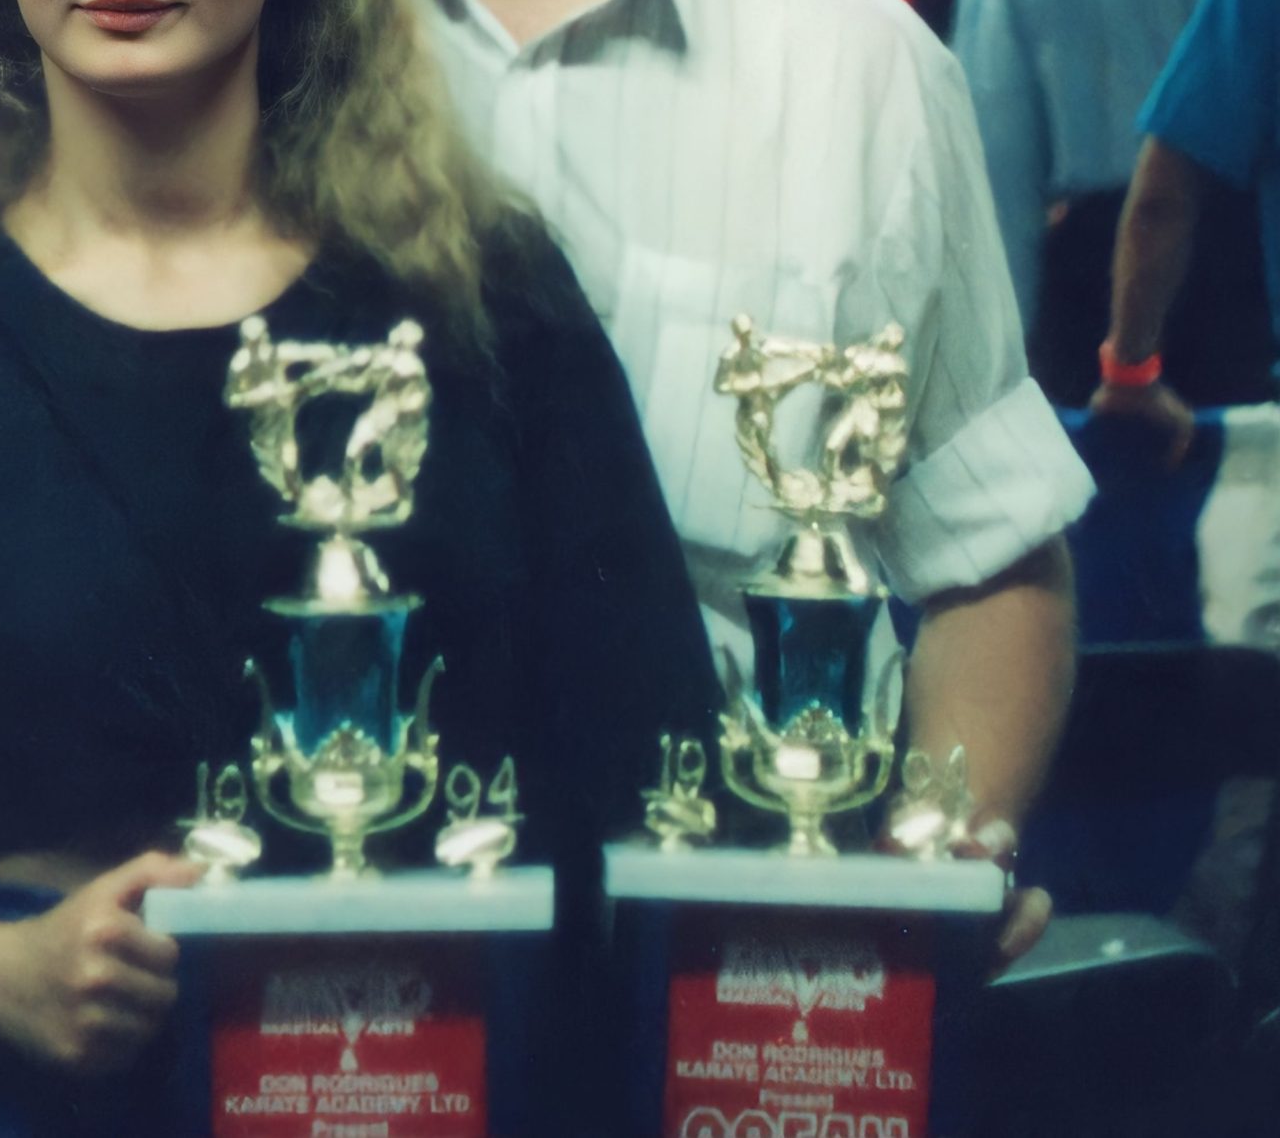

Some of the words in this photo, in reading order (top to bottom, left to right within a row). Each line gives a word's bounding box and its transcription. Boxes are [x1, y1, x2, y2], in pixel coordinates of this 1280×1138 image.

[445, 756, 518, 822] 94
[712, 1040, 757, 1062] DON
[259, 1074, 307, 1093] DON
